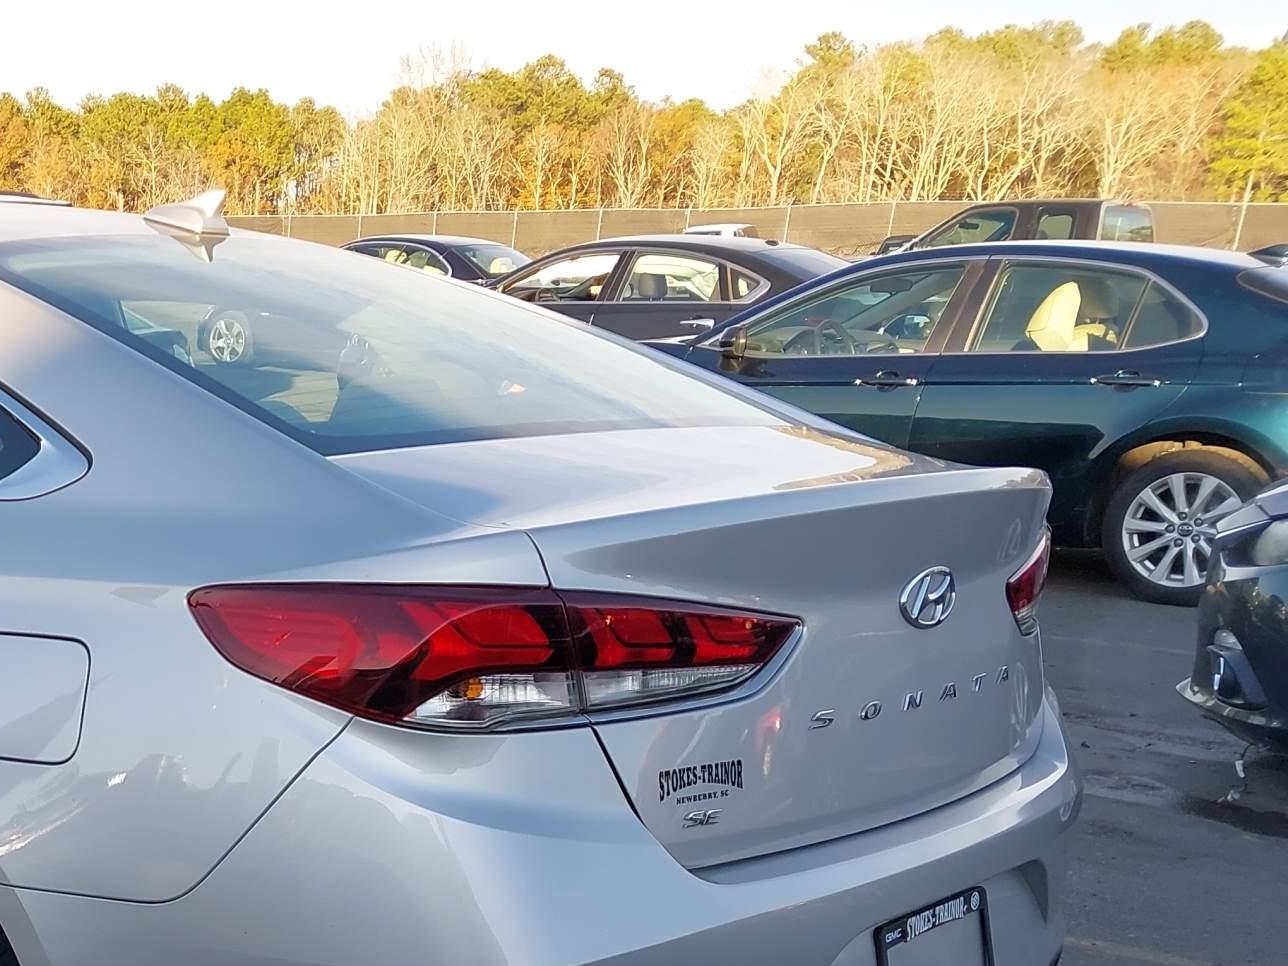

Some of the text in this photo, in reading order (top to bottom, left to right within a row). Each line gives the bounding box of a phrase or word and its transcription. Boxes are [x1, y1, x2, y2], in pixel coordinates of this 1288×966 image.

[808, 665, 1009, 731] SONATA
[659, 759, 743, 802] STOKES-TRAINOR
[676, 789, 730, 805] NEWBERRY, SC
[681, 808, 723, 829] SE
[885, 896, 966, 943] GMC STOKES-TRAINOR
